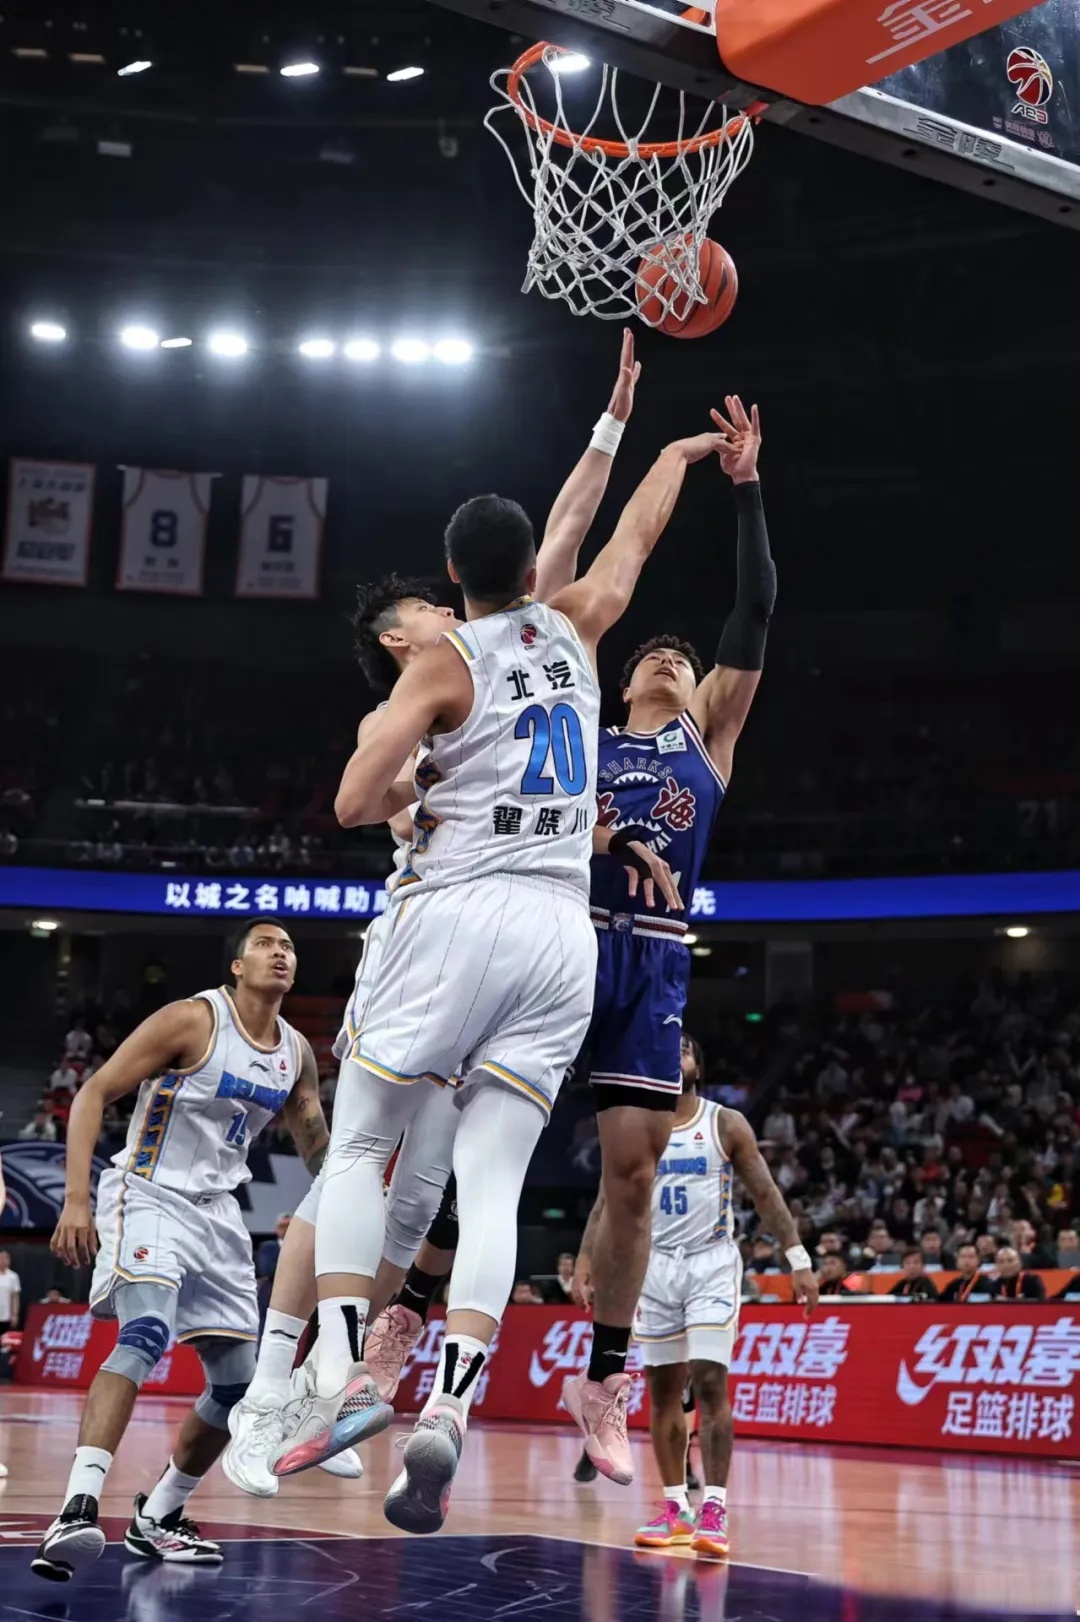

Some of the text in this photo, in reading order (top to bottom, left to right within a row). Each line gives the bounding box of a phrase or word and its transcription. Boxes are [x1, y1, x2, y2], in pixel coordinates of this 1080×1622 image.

[151, 509, 178, 548] 8
[267, 514, 295, 553] 6
[506, 660, 576, 700] 北汽
[514, 703, 588, 796] 20
[599, 757, 674, 783] SHARKS
[660, 1186, 688, 1215] 45
[914, 1317, 1080, 1387] 红双喜
[732, 1382, 837, 1428] 足篮排球
[941, 1390, 1075, 1442] 足篮排球
